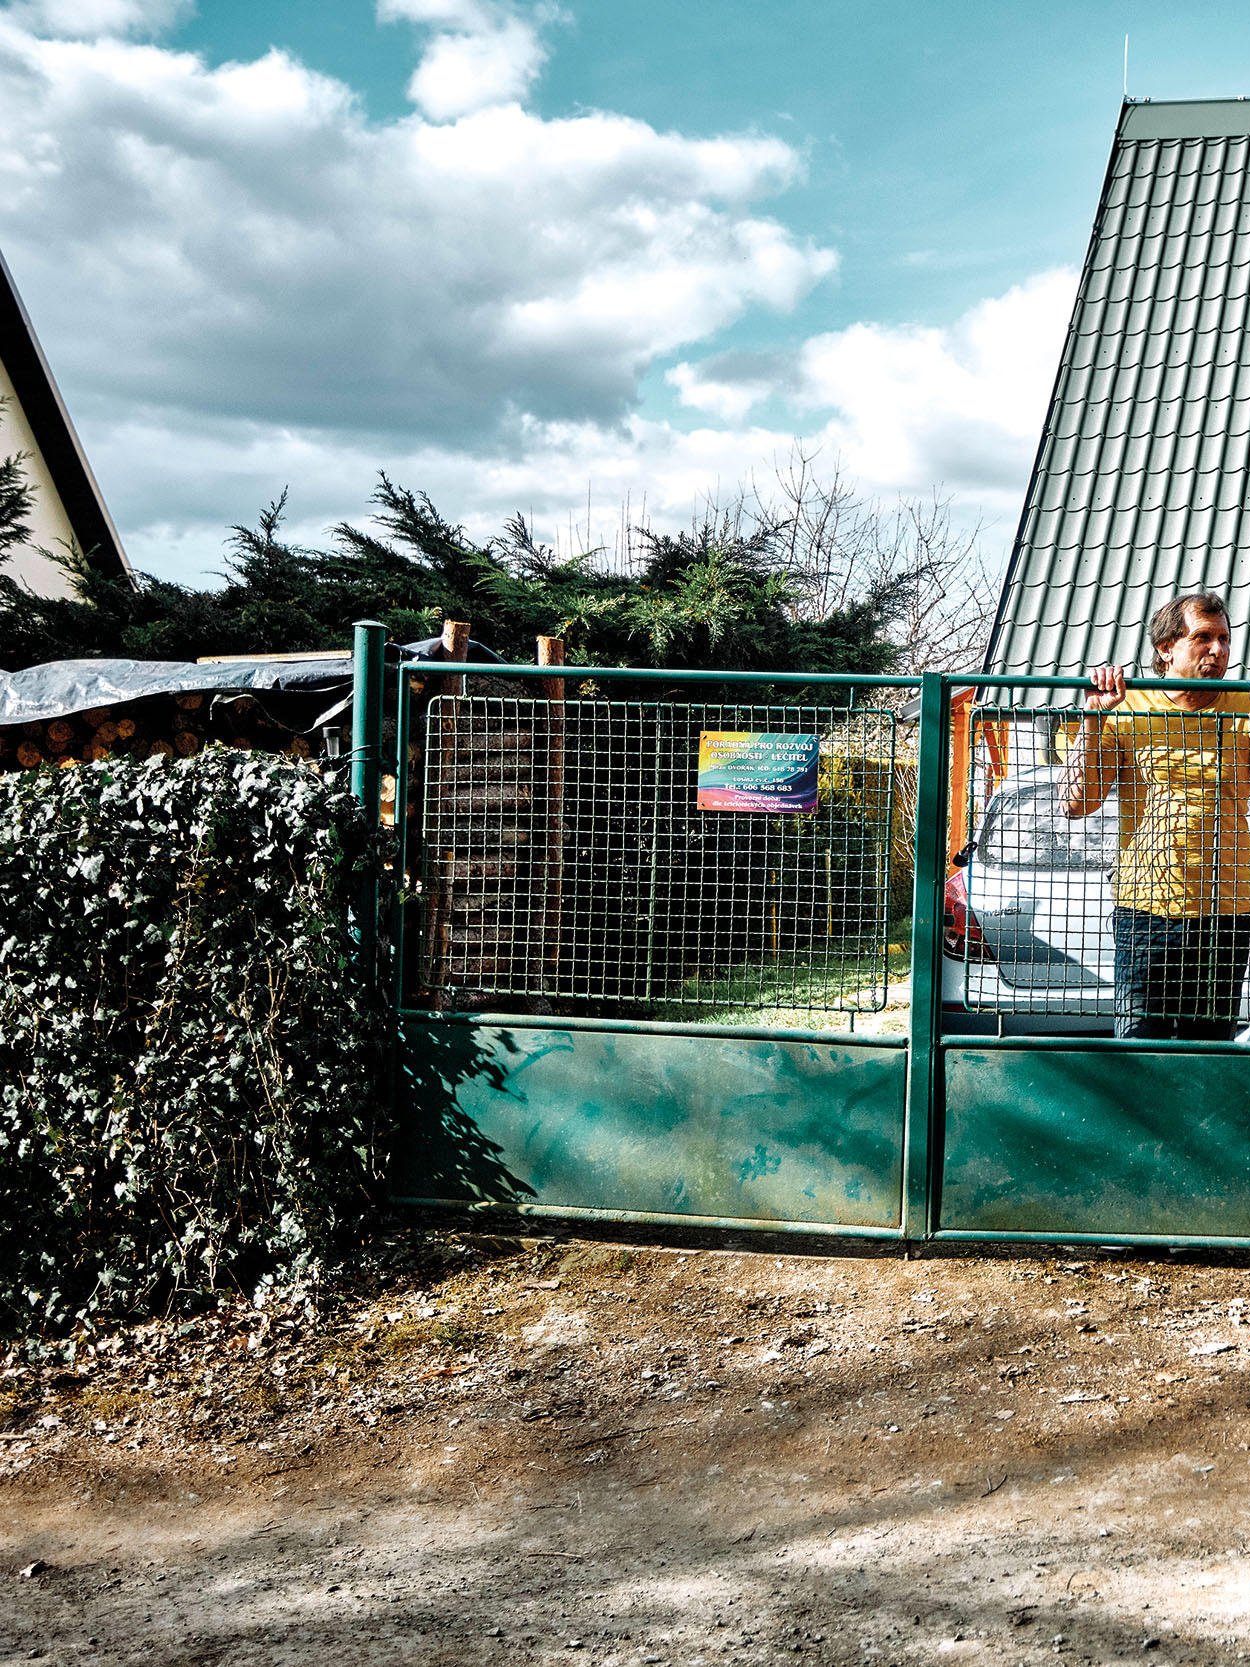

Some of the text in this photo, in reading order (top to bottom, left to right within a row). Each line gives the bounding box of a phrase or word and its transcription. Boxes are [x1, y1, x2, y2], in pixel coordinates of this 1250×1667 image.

[706, 740, 814, 751] PORADNA PRO ROZVOJ
[710, 751, 762, 760] OSOBNOSTI
[771, 752, 808, 762] LÉČITEL
